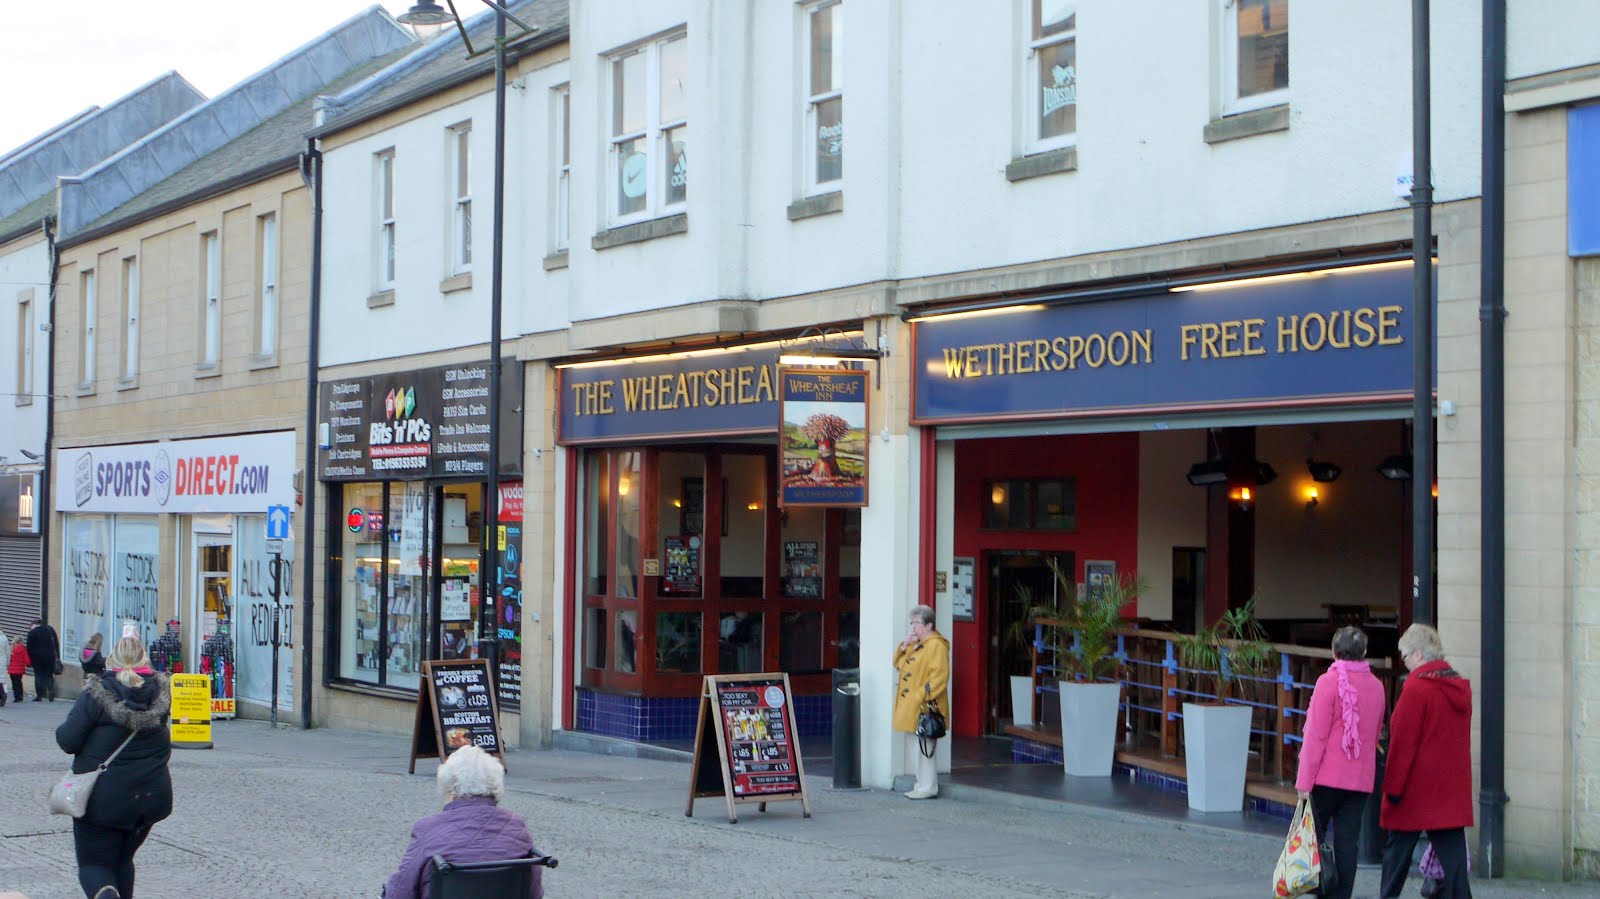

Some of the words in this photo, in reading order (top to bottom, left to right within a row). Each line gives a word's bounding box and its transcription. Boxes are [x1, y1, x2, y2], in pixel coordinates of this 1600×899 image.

[943, 329, 1153, 379] WETHERSPOON
[1180, 318, 1266, 361] FREE
[1277, 304, 1404, 353] HOUSE
[458, 368, 486, 380] Unlocking
[454, 386, 488, 398] Accessories
[790, 379, 859, 395] WHEATSHEAF
[571, 380, 615, 416] THE
[816, 392, 832, 401] INN
[469, 404, 486, 416] Cards
[370, 422, 393, 444] Bits
[407, 418, 431, 442] PCs
[465, 423, 490, 434] Welcome
[462, 460, 484, 472] Players
[96, 460, 151, 497] SPORTS
[126, 552, 156, 584] STOCK
[241, 558, 262, 598] ALL
[444, 675, 479, 683] COFFEE
[443, 716, 492, 725] BREAKFAST
